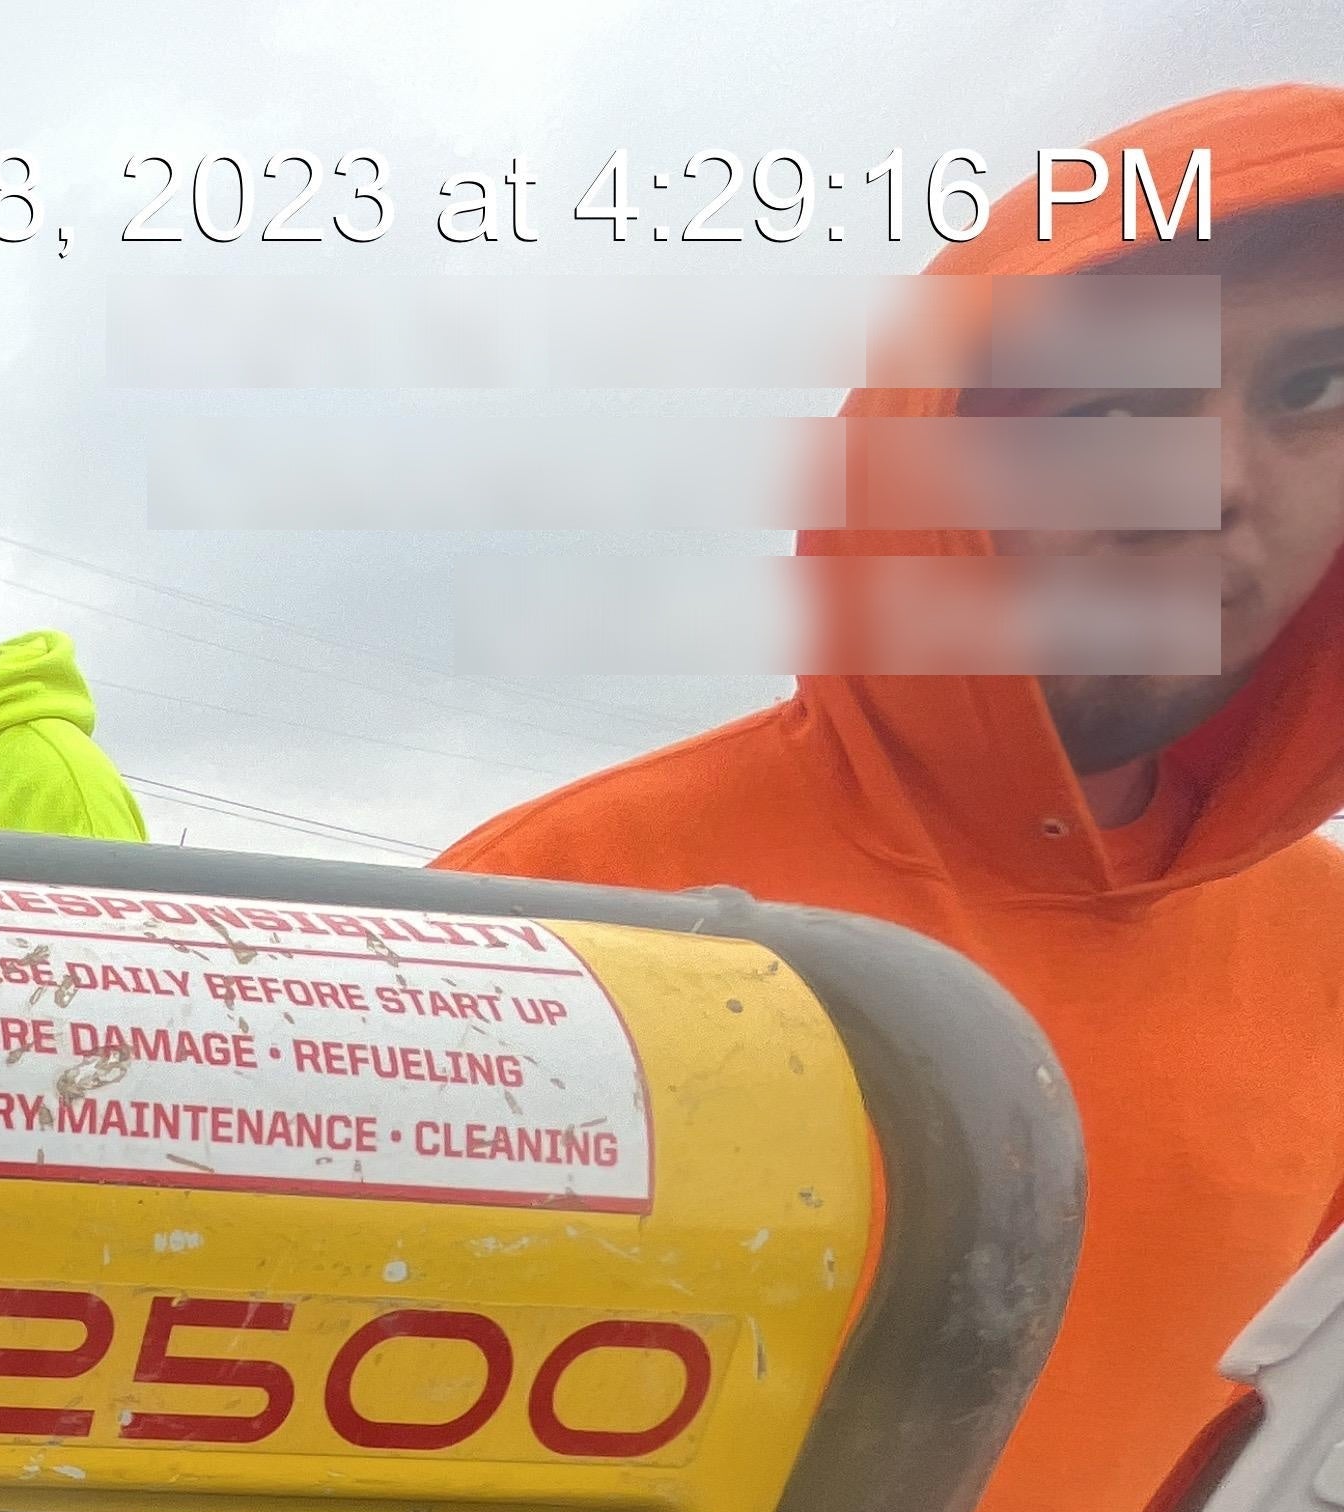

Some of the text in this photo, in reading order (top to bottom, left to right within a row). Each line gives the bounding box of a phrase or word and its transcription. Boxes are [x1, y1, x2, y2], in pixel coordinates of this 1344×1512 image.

[64, 960, 190, 998] DAILY
[202, 972, 370, 1012] BEFORE
[375, 986, 505, 1022] START
[511, 996, 568, 1027] UP
[70, 1022, 258, 1069] DAMAGE
[292, 1038, 524, 1089] REFUELING
[55, 1097, 378, 1153] MAINTENANCE
[415, 1119, 620, 1168] CLEANING
